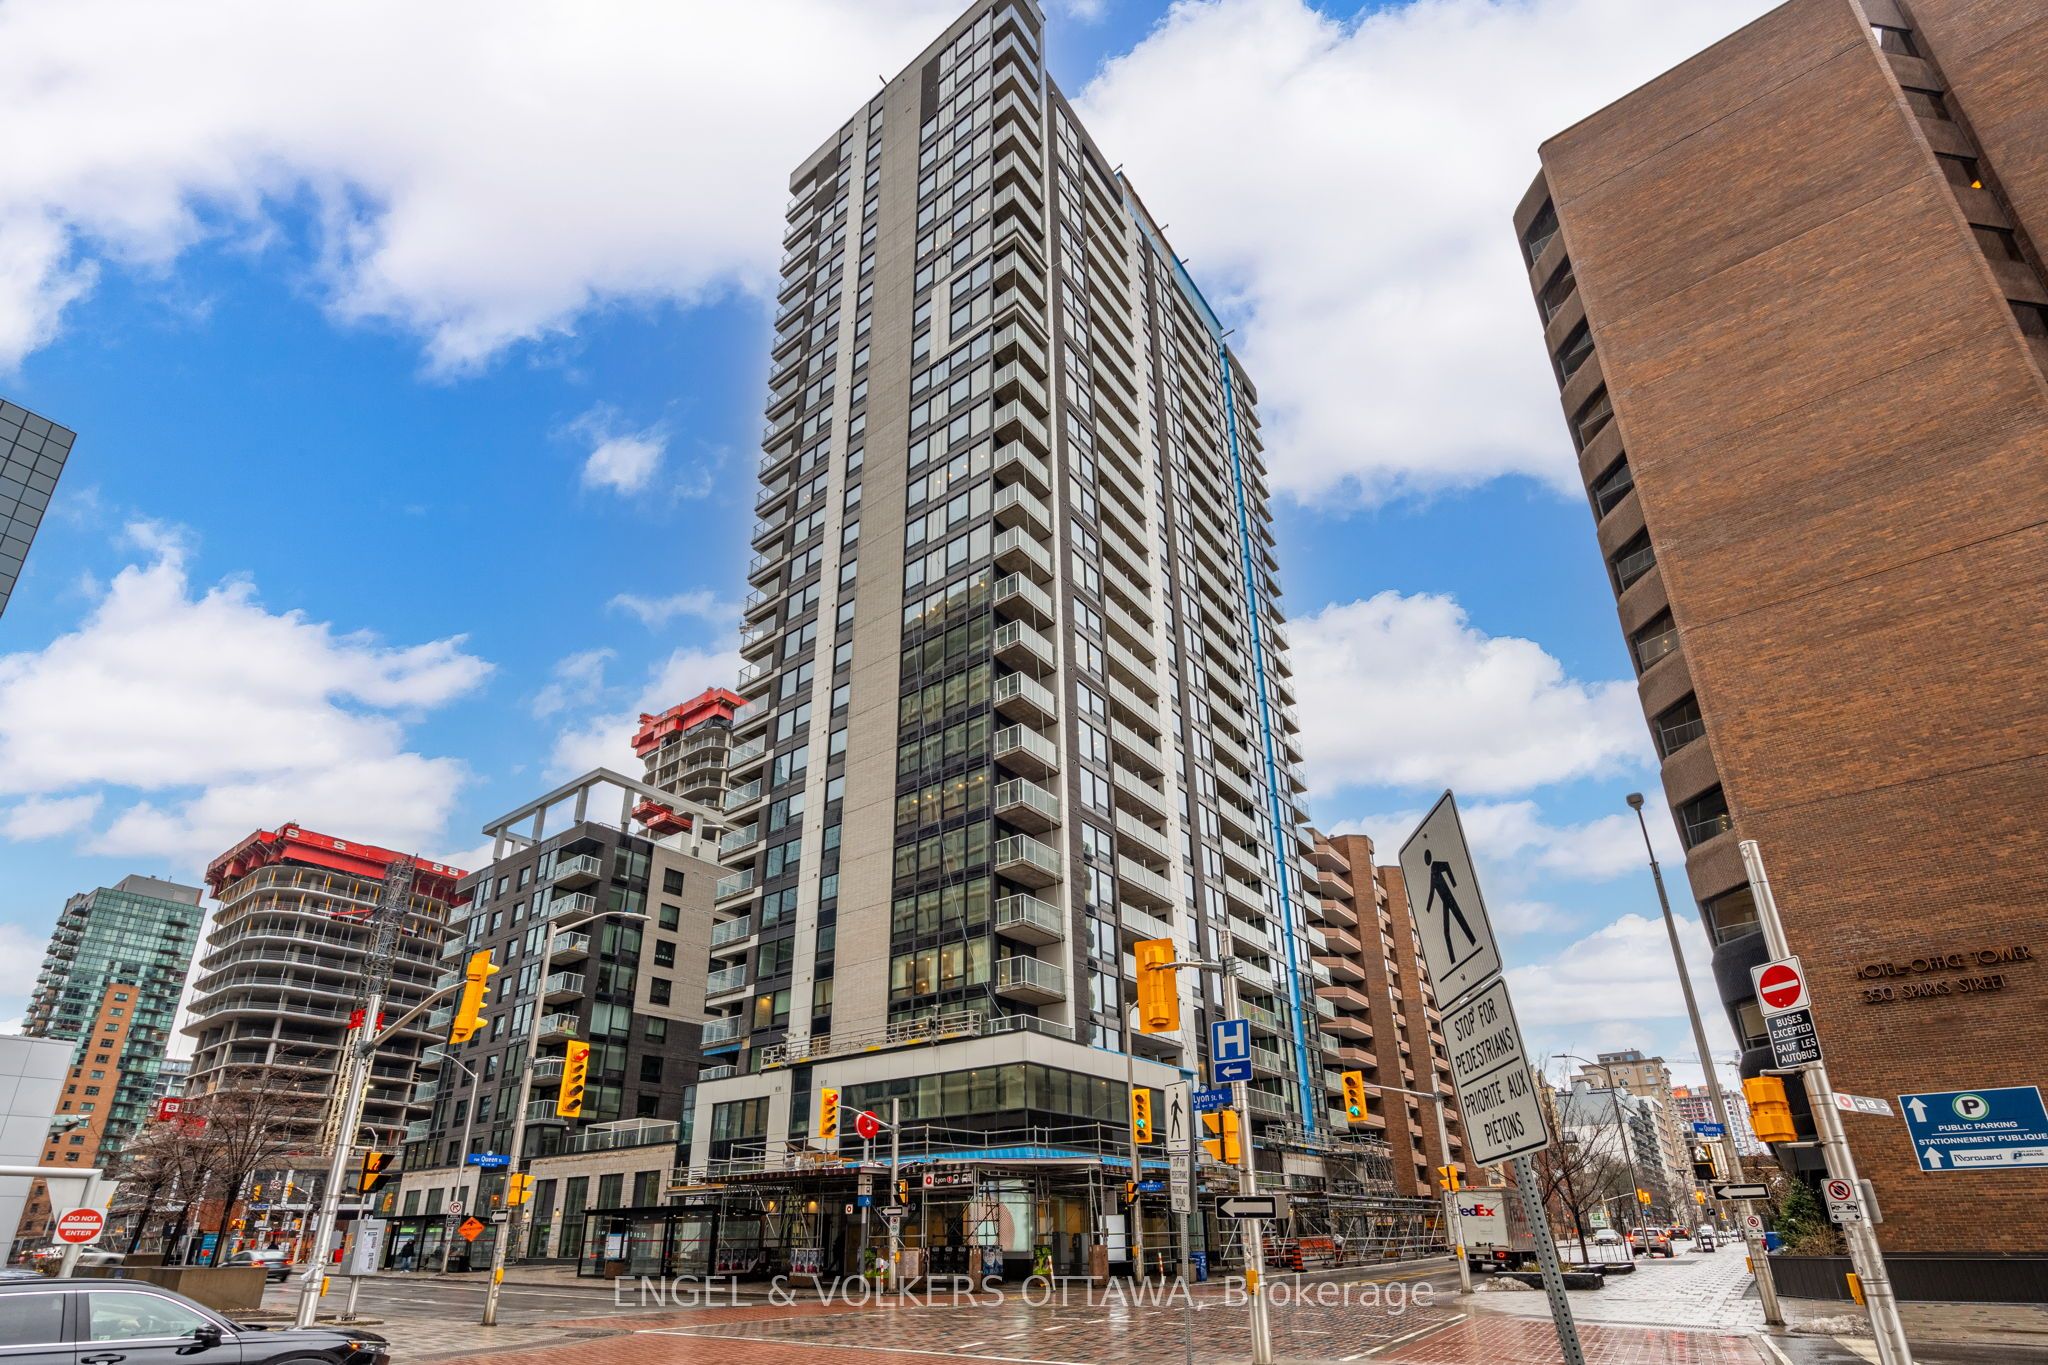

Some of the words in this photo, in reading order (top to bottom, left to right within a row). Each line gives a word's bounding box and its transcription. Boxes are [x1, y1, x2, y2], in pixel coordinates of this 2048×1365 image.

[1971, 945, 2033, 965] TOWER
[1863, 986, 1895, 1004] 350
[1901, 980, 1951, 999] SPARKS
[1957, 974, 2007, 993] STREET
[1454, 1011, 1476, 1042] STOP
[1477, 998, 1498, 1028] FOR
[1776, 1014, 1803, 1028] BUSES
[1772, 1023, 1812, 1039] EXCEPTED
[1218, 1023, 1245, 1058] H
[1776, 1042, 1797, 1053] SAUF
[1801, 1037, 1817, 1048] LES
[1455, 1027, 1515, 1078] PEDESTRIANS
[1781, 1049, 1818, 1064] AUTOBUS
[1193, 1094, 1210, 1105] Lyon
[1464, 1074, 1506, 1118] PRIORITÉ
[1508, 1069, 1529, 1100] AUX
[1961, 1099, 1980, 1115] P
[1484, 1111, 1525, 1147] PIÉTONS
[1938, 1123, 1973, 1131] PUBLIC
[1975, 1121, 2018, 1129] PARKING
[1919, 1135, 1996, 1146] STATIONNEMENT
[1998, 1133, 2048, 1142] PUBLIQUE
[481, 1155, 498, 1163] Queen
[1459, 1204, 1495, 1217] edEx
